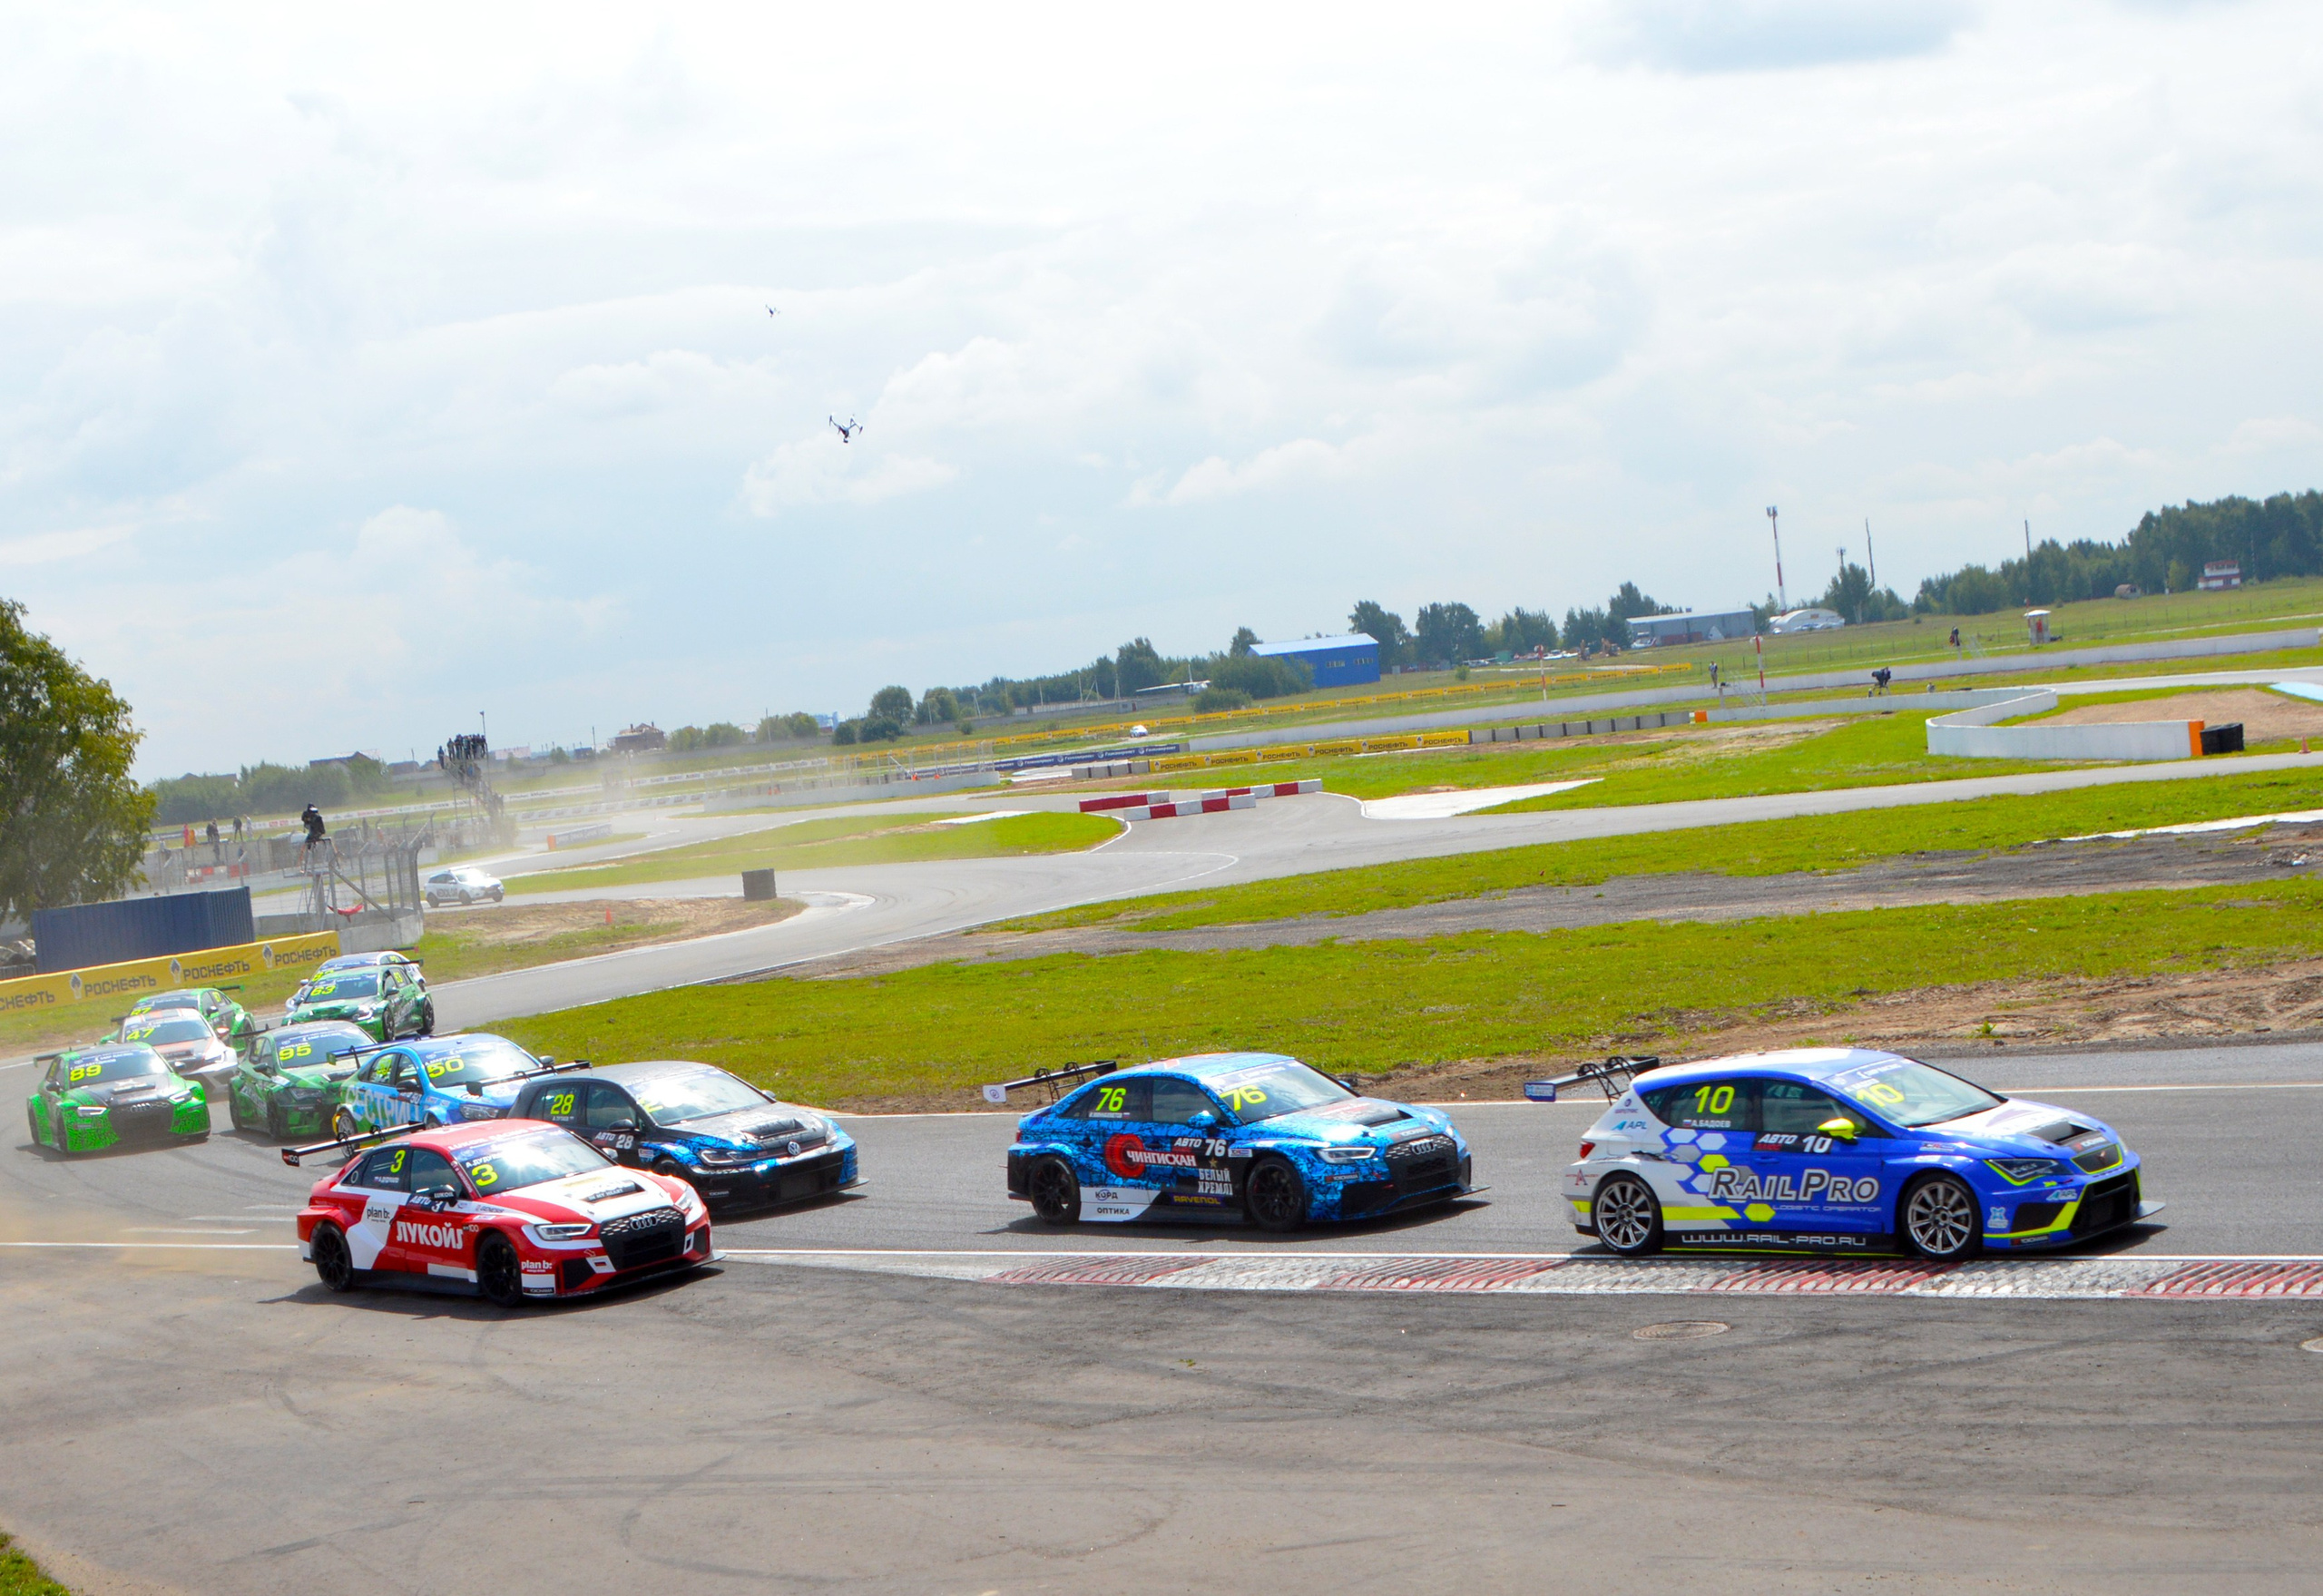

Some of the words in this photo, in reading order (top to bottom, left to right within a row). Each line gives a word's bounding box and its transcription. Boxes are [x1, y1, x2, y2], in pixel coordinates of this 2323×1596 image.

[274, 945, 338, 965] РОСНЕФТЬ
[183, 959, 250, 981] РОСНЕФТЬ
[84, 974, 157, 997] РОСНЕФТЬ
[310, 984, 337, 997] 63
[126, 1027, 155, 1041] 47
[279, 1044, 312, 1061] 95
[69, 1063, 102, 1082] 89
[426, 1057, 466, 1079] 50
[551, 1093, 575, 1115] 28
[1094, 1087, 1126, 1112] 76
[1219, 1084, 1268, 1112] 76
[1693, 1085, 1736, 1115] 10
[1856, 1082, 1906, 1108] 10
[1626, 1121, 1648, 1130] APL
[595, 1131, 616, 1141] АВТО
[615, 1134, 634, 1150] 28
[1173, 1137, 1202, 1148] АВТО
[1204, 1139, 1227, 1158] 76
[1758, 1133, 1799, 1145] АВТО
[1801, 1135, 1833, 1154] 10
[390, 1150, 407, 1173] 3
[1125, 1150, 1198, 1167] ЧИНГИСХАН
[471, 1163, 499, 1187] 3
[1198, 1167, 1231, 1182] БЕЛЫЙ
[409, 1195, 431, 1205] АВТО
[1094, 1190, 1119, 1200] КОРД
[1172, 1194, 1221, 1205] RAVENOL
[366, 1206, 383, 1219] plan
[1096, 1207, 1131, 1215] ОПТИКА
[521, 1259, 542, 1271] plan
